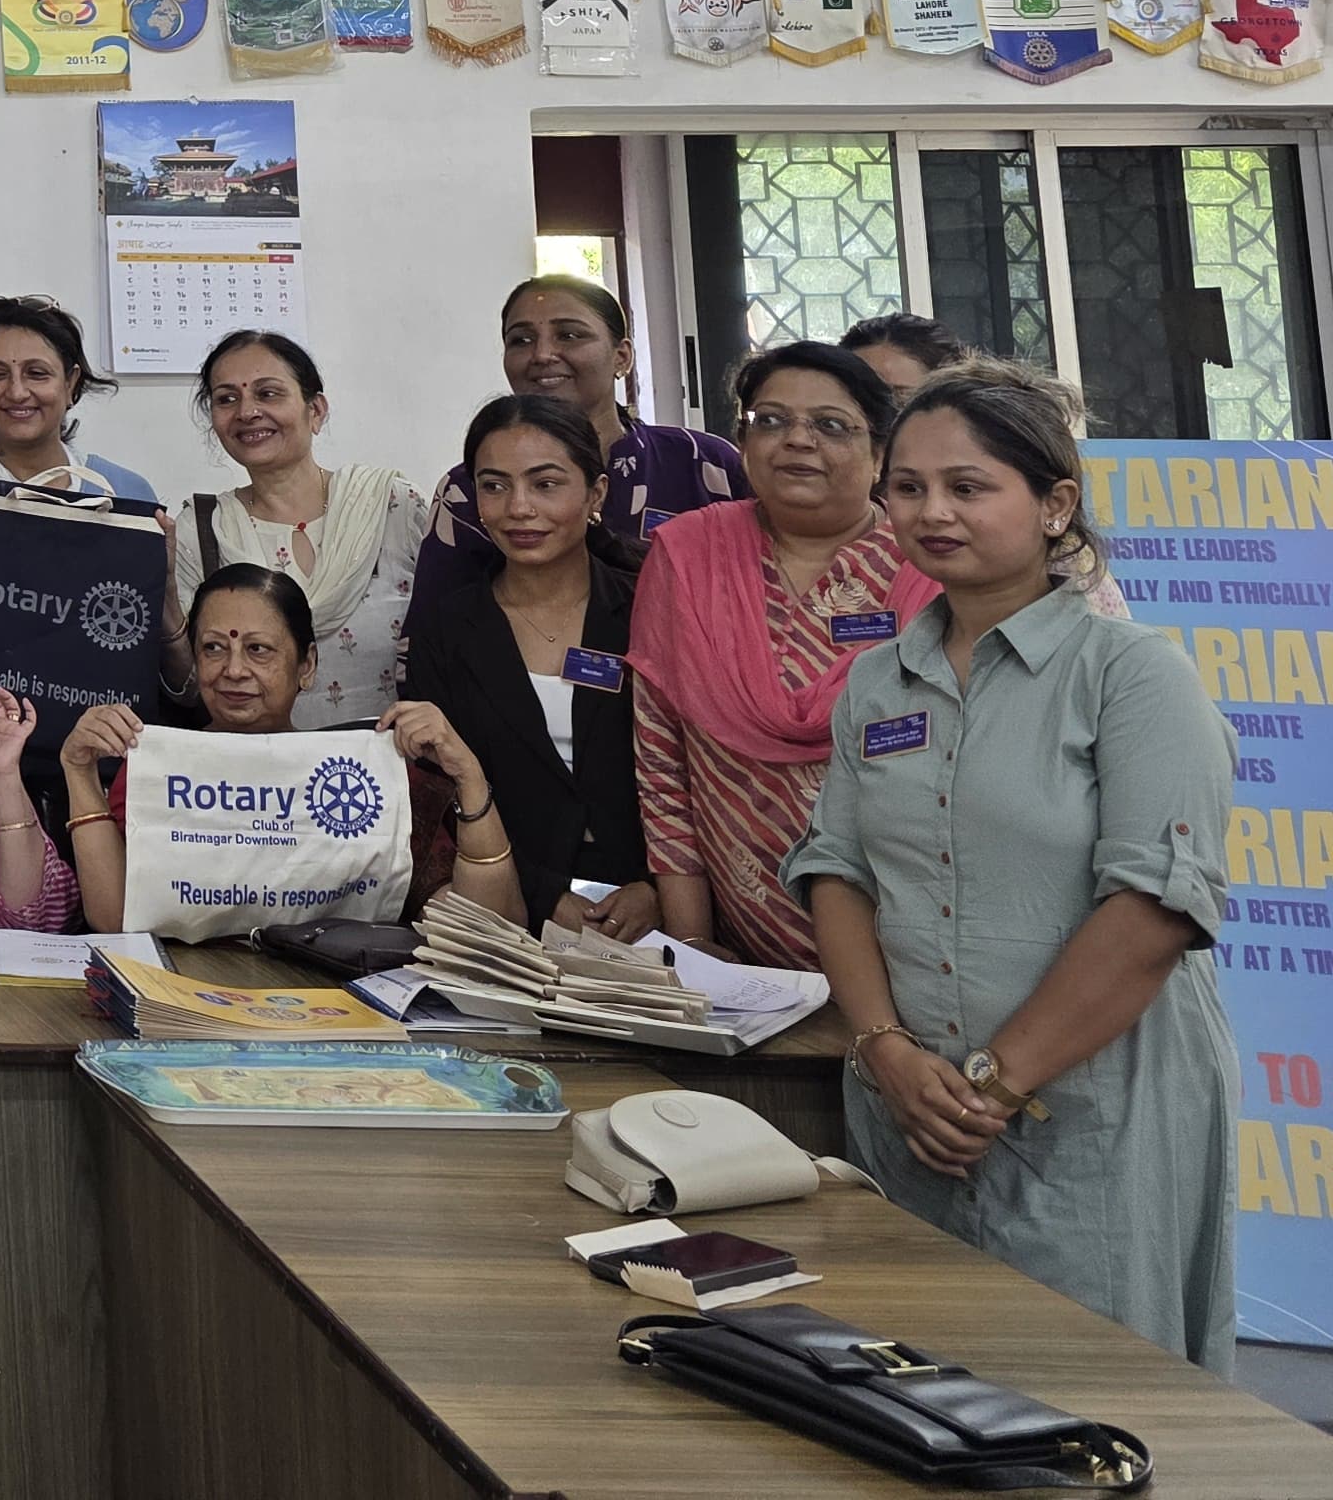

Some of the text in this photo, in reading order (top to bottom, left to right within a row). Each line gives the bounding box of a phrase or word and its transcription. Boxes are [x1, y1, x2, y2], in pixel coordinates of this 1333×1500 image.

[915, 1, 948, 9] LAHORE
[915, 11, 952, 20] SHAHEEN
[1221, 17, 1302, 26] GEORGETOWN
[66, 56, 106, 64] 2011-12
[1083, 457, 1333, 530] TARIAN
[1183, 538, 1277, 563] LEADERS
[1168, 580, 1331, 606] AND ETHICALLY
[32, 675, 44, 696] is
[326, 765, 357, 775] ROTARY
[167, 775, 296, 820] Rotary
[252, 820, 294, 831] Club of
[171, 831, 297, 846] Biratnagar Downtown
[171, 881, 277, 907] "Reusable is
[1247, 899, 1331, 928] BETTER
[1244, 945, 1270, 971] AT
[1280, 947, 1296, 972] A
[1257, 1052, 1322, 1108] TO
